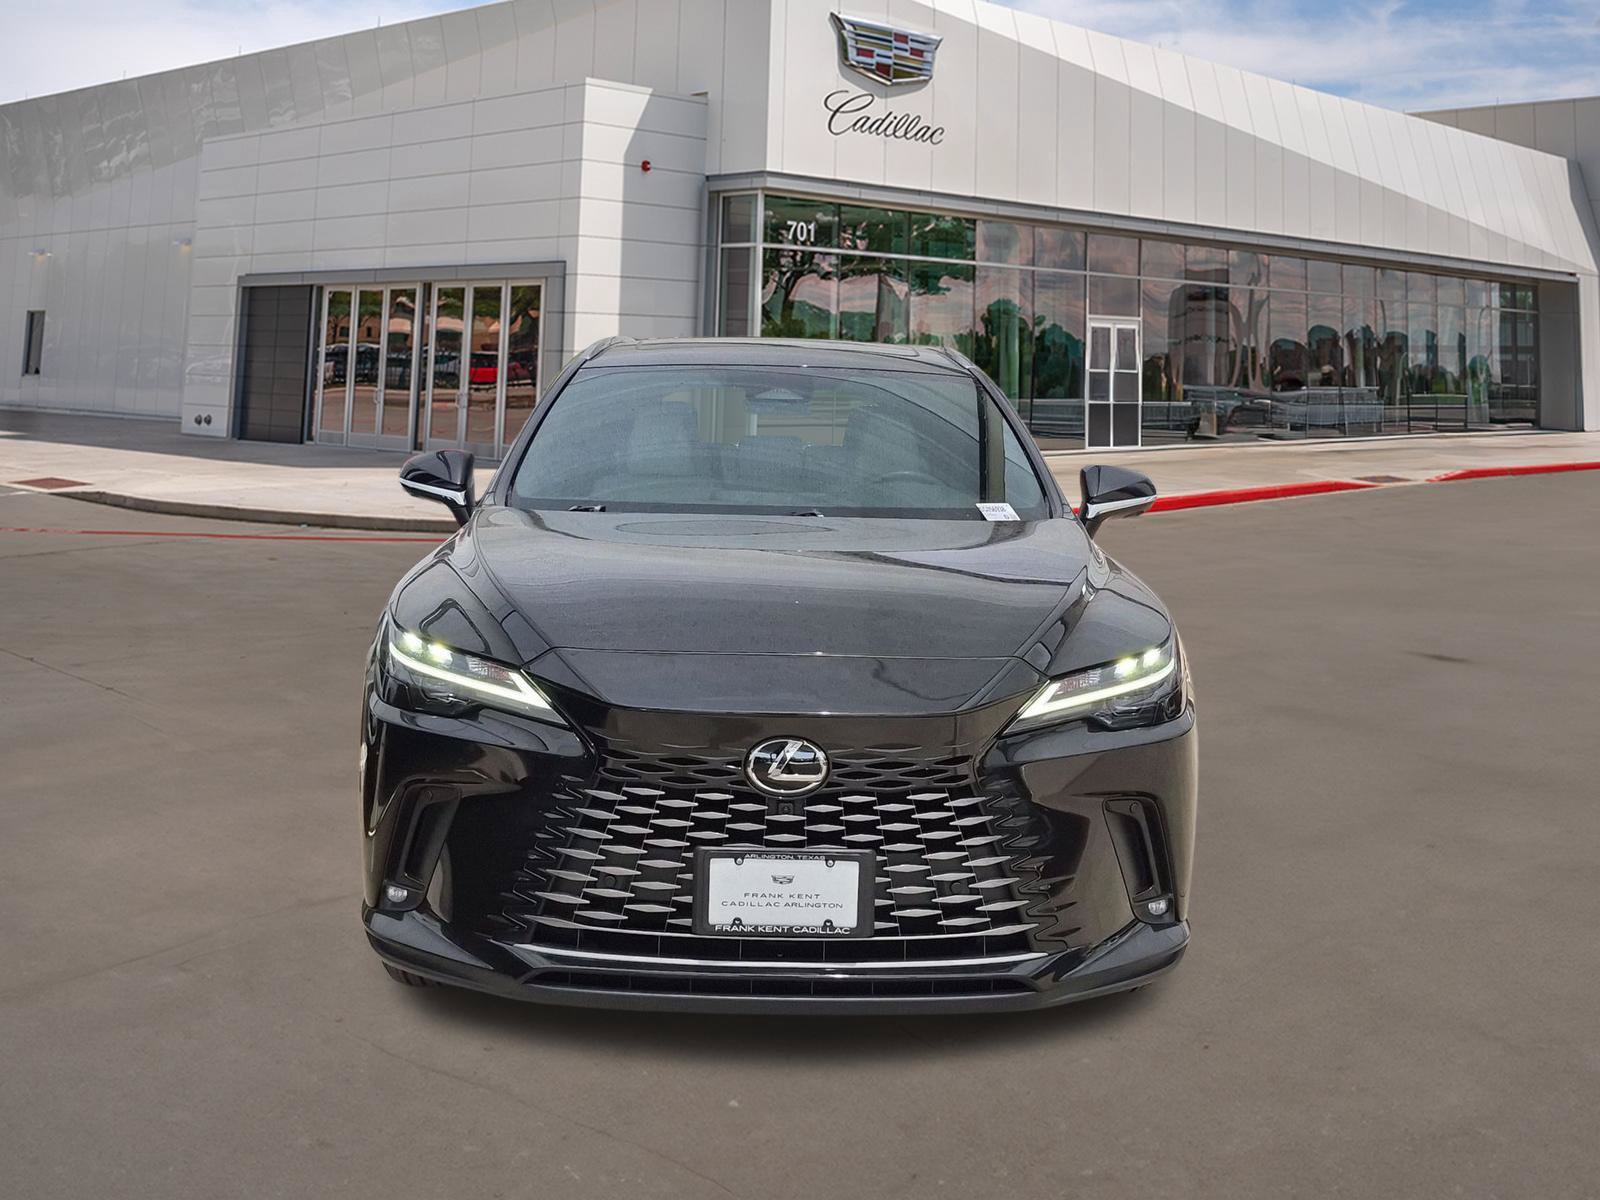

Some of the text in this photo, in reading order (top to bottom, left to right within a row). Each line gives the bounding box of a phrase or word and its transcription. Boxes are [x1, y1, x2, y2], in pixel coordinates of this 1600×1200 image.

[823, 90, 945, 145] Cadillac
[786, 220, 816, 242] 701
[743, 892, 785, 900] FRANK
[721, 900, 844, 909] CADILLAC ARLINGTON
[714, 924, 850, 935] FRANK KENT CADILLAC
